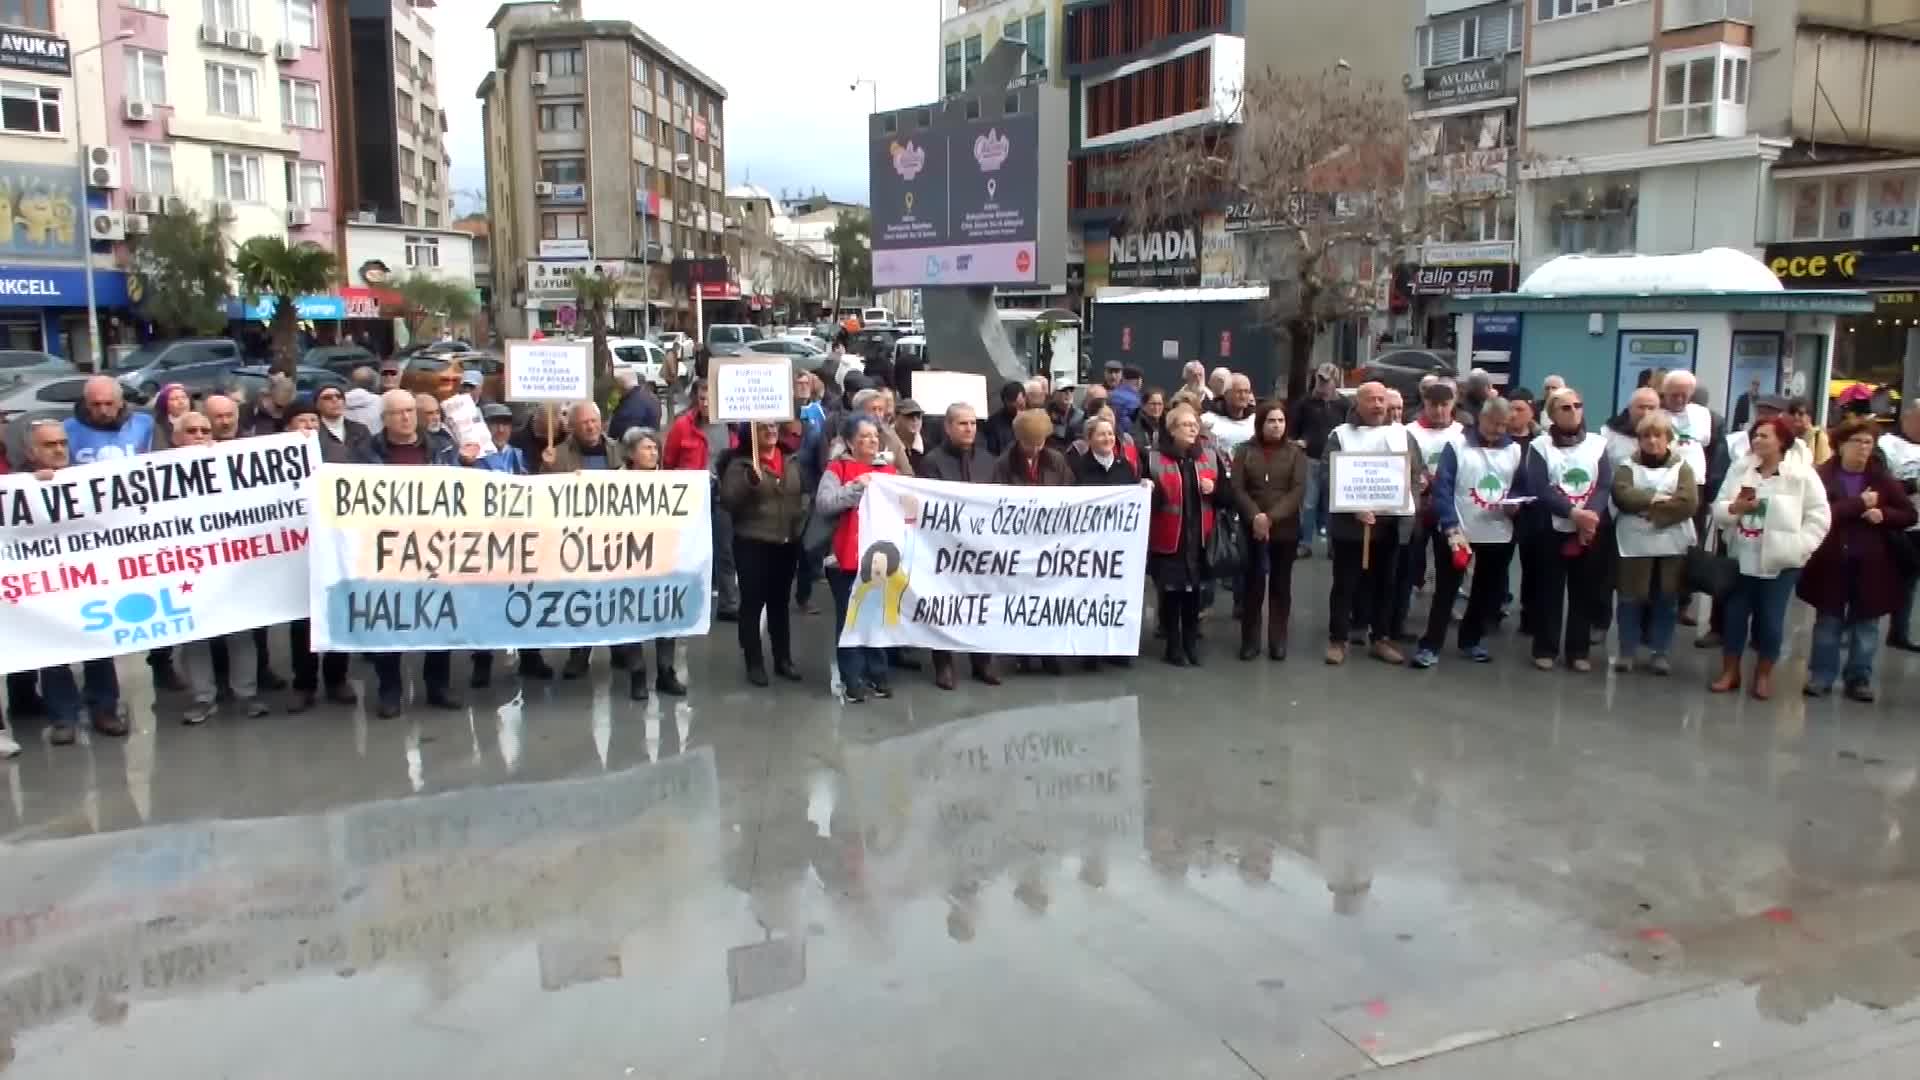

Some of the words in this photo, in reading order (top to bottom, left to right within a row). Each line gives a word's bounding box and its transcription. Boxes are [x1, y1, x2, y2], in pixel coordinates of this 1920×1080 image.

[1, 33, 66, 57] AVUKAT
[1109, 229, 1196, 264] NEVADA
[1417, 267, 1453, 286] talip
[1457, 270, 1494, 286] gsm
[40, 483, 84, 523] VE
[89, 461, 222, 514] FAŞİZME
[227, 443, 312, 490] KARŞI
[335, 477, 467, 517] BASKILAR
[547, 480, 689, 517] YILDIRAMAZ
[67, 516, 195, 552] DEMOKRATİK
[921, 501, 966, 532] HAK
[118, 526, 309, 581] DEĞİŞTİRELİM
[376, 530, 539, 578] FAŞİZME
[559, 526, 655, 571] ÖLÜM
[935, 543, 1021, 576] DİRENE
[1036, 542, 1125, 579] DİRENE
[80, 587, 191, 631] SOL
[348, 587, 458, 632] HALKA
[505, 581, 687, 630] ÖZGÜRLÜK
[912, 594, 991, 627] BİRLİKTE
[1003, 594, 1127, 628] KAZANACAĞIZ
